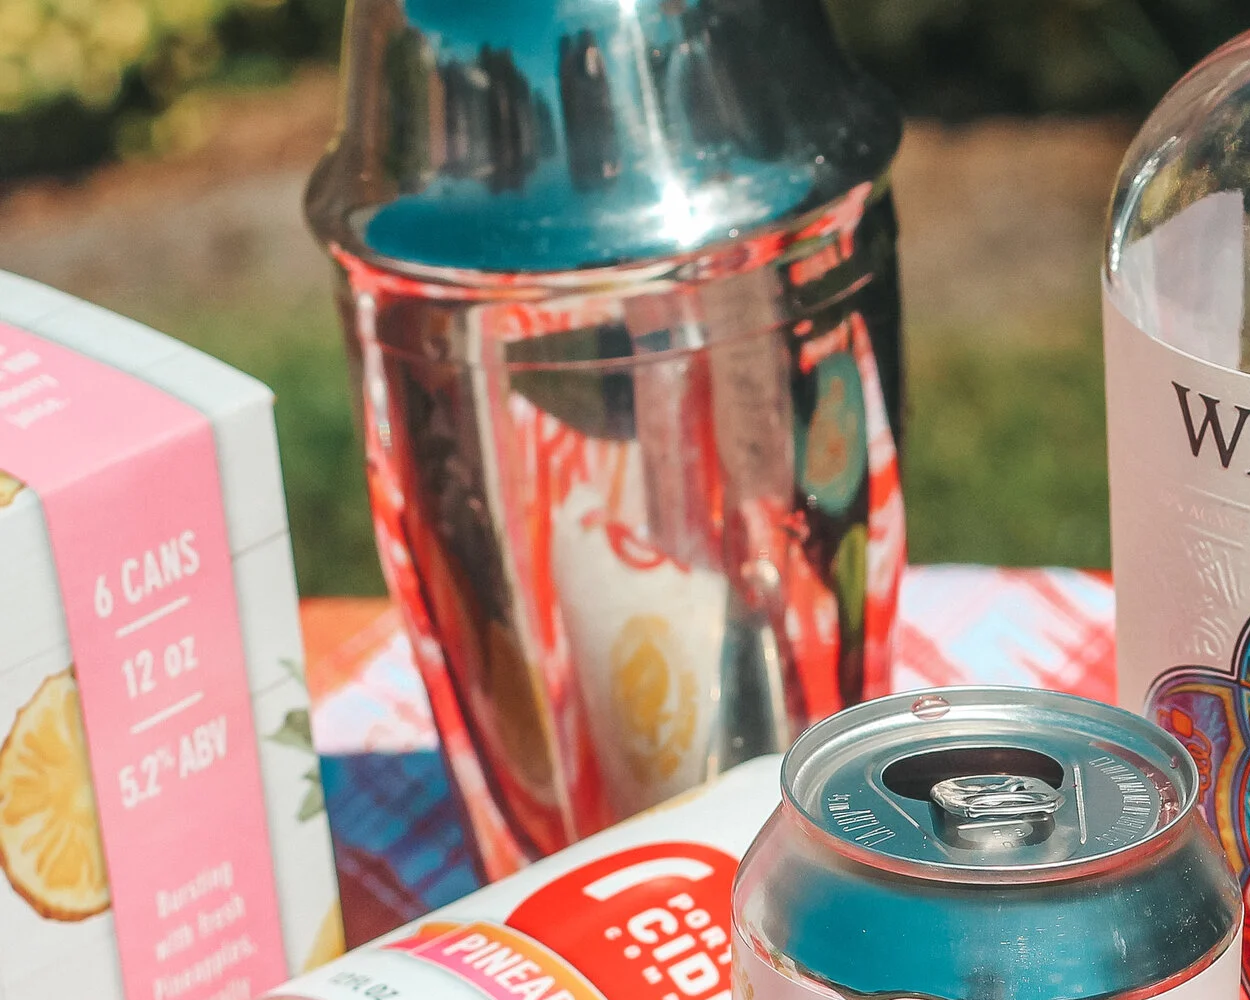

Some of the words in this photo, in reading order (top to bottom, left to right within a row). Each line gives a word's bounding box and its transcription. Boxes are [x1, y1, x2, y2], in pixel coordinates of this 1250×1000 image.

[94, 574, 114, 619] 6
[121, 529, 200, 604] CANS
[121, 648, 157, 699] 12
[179, 714, 228, 780] ABV
